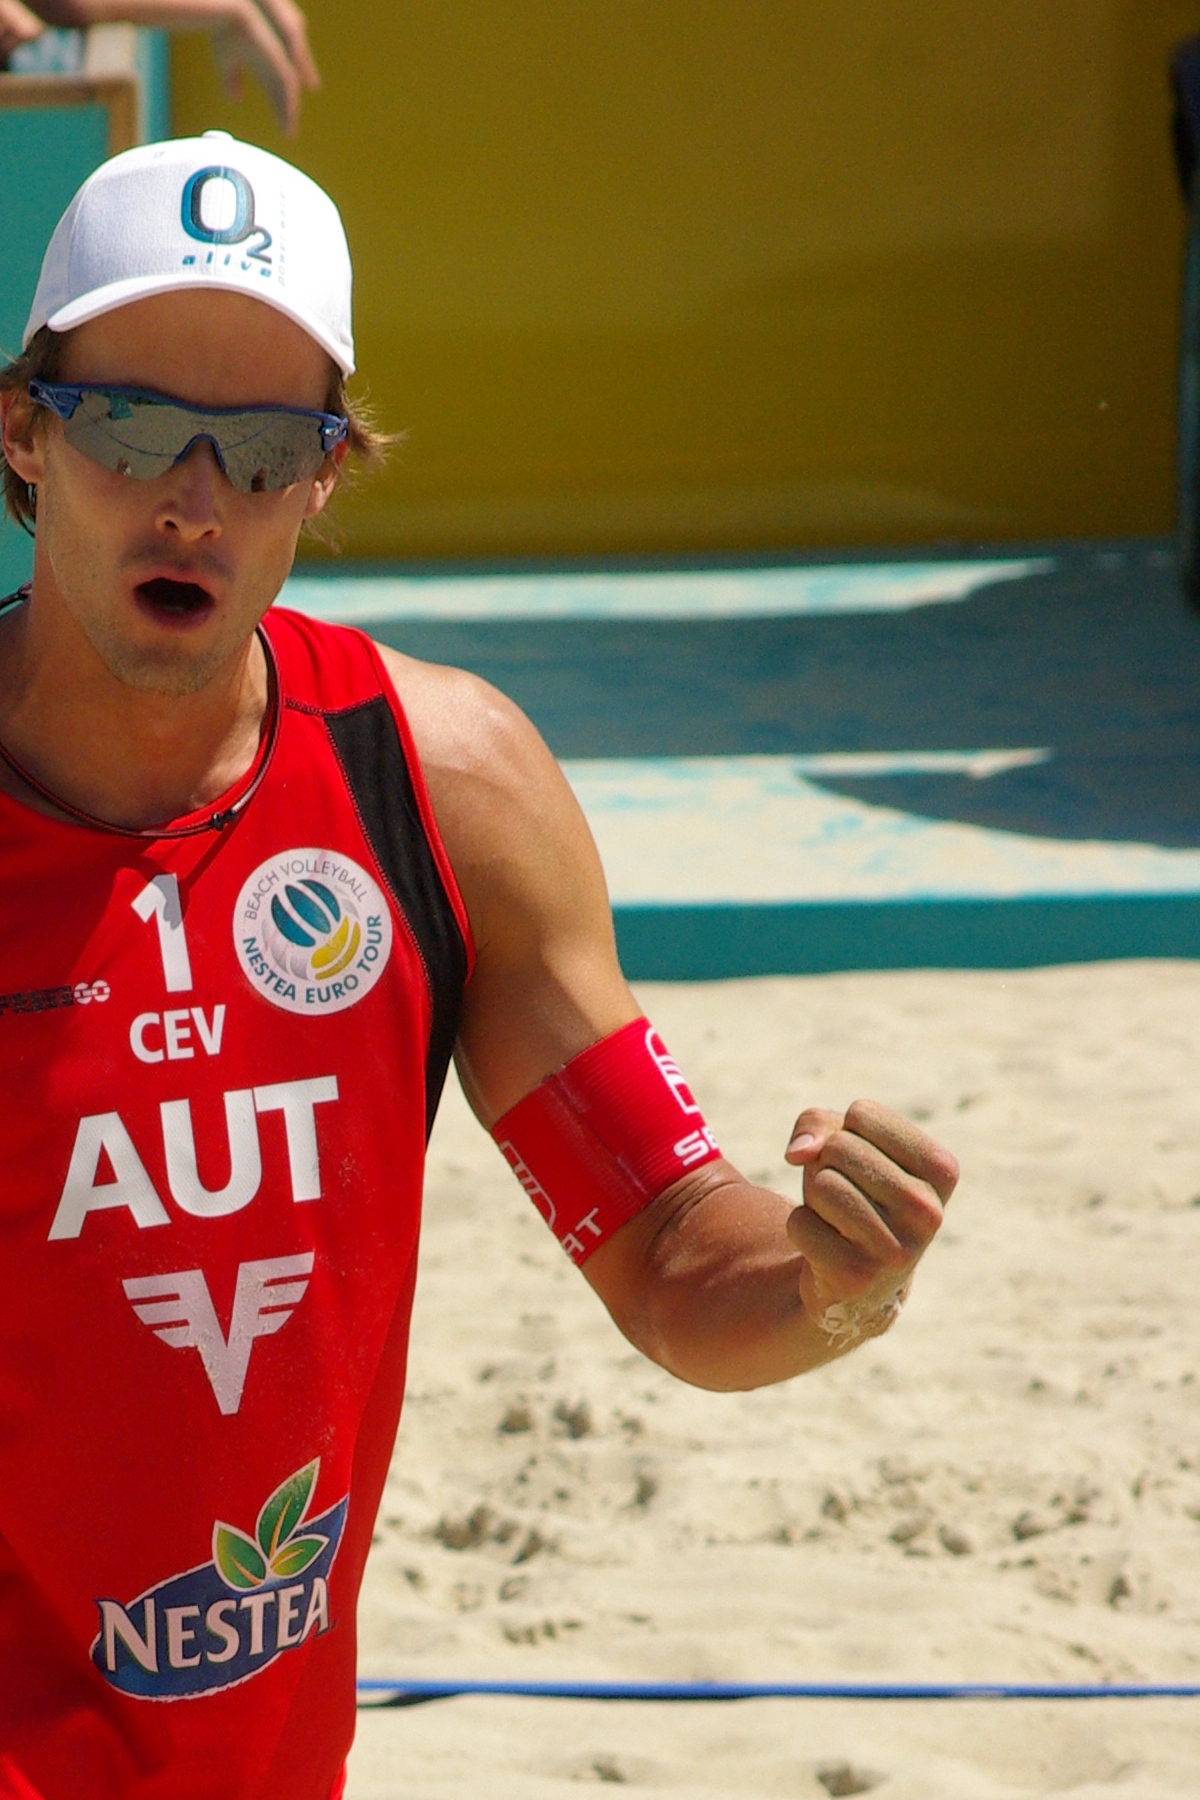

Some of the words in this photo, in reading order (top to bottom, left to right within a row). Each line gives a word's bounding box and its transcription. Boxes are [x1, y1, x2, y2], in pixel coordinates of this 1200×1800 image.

[182, 251, 272, 278] alive
[131, 873, 193, 993] 1
[244, 868, 281, 921] BEACH
[279, 859, 369, 903] VOLLEYBALL
[242, 936, 297, 1002] NESTEA
[305, 973, 360, 1005] EURO
[356, 913, 384, 974] TOUR
[129, 1004, 227, 1064] CEV
[47, 1075, 340, 1242] AUT
[97, 1577, 331, 1674] NESTEA
